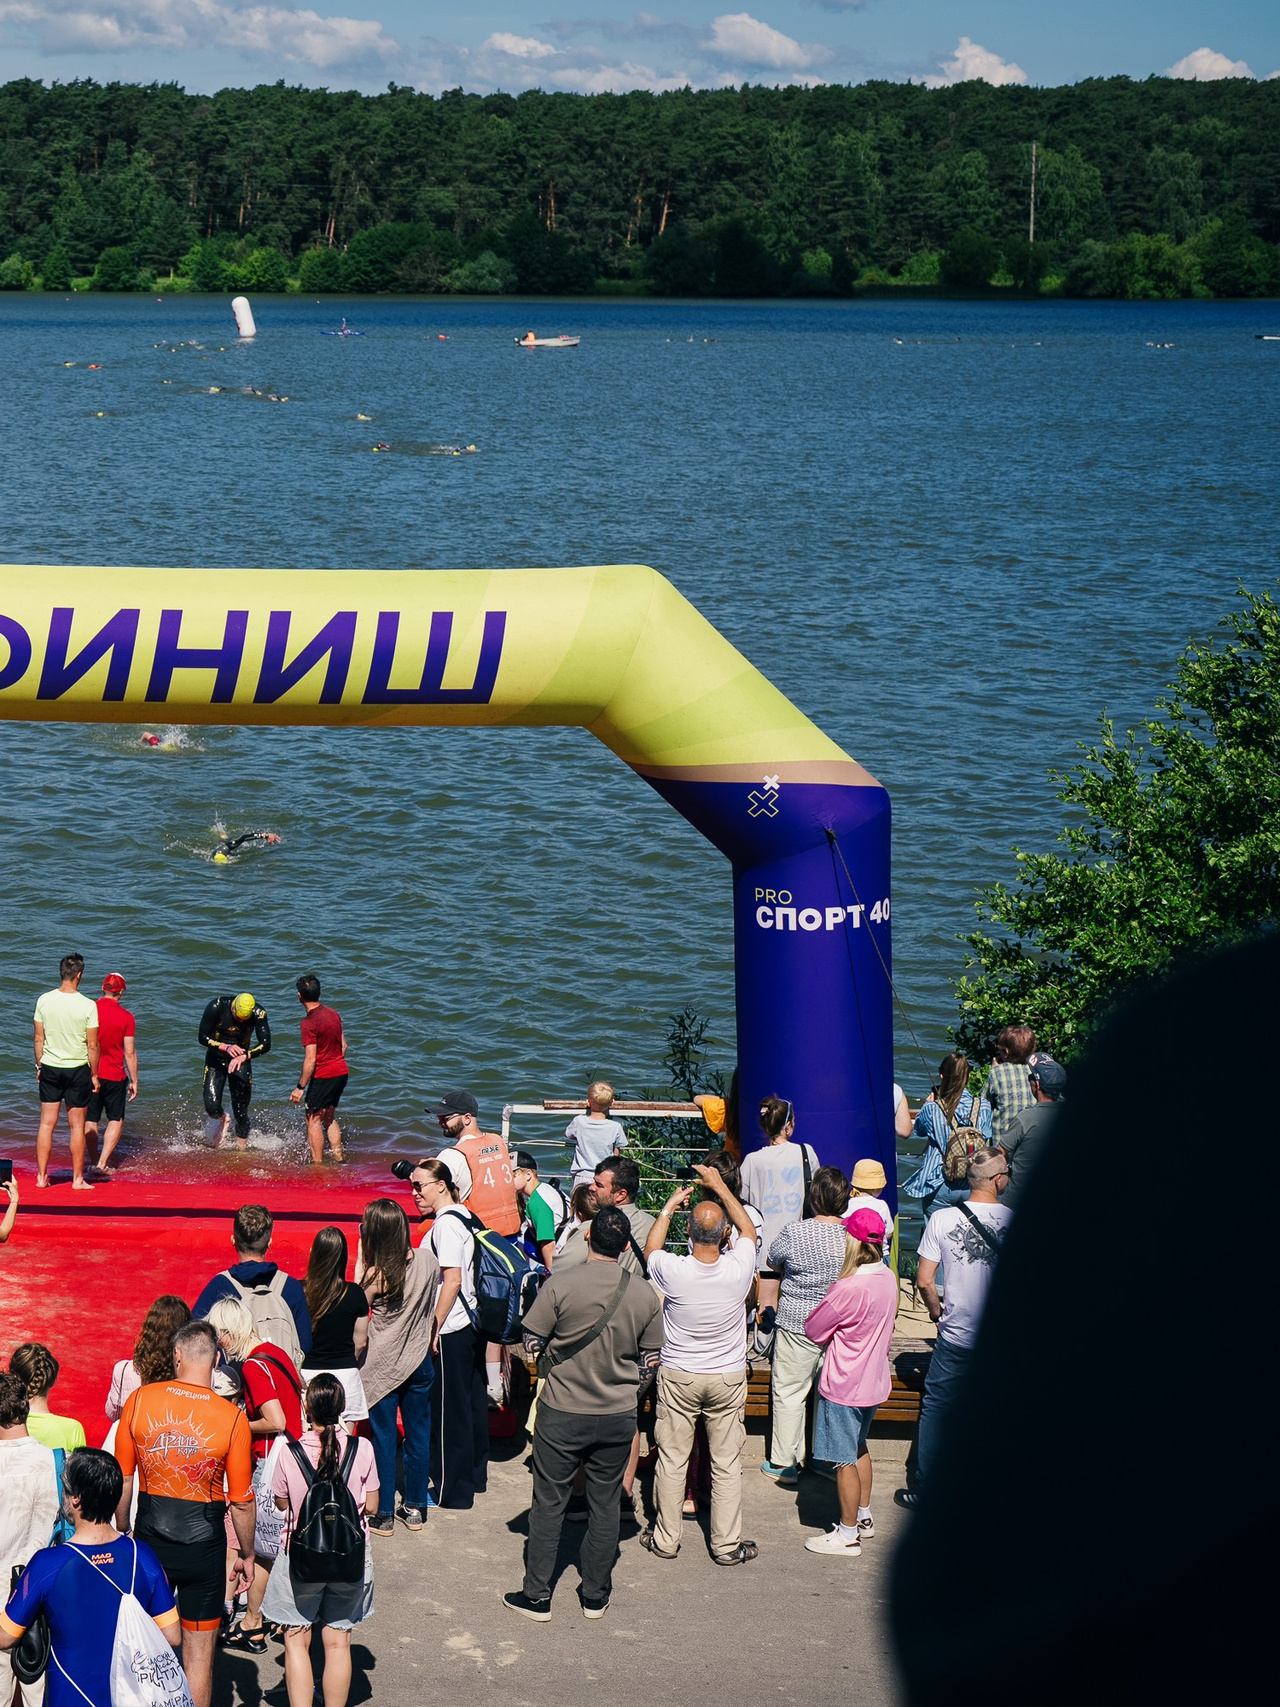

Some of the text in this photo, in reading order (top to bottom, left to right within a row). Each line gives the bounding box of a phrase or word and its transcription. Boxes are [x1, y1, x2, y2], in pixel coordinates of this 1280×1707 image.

[755, 887, 793, 905] PRO
[756, 897, 891, 932] СПОРТ 40
[763, 1191, 802, 1214] 29
[166, 1386, 211, 1401] МУДРЕЦКИЙ
[91, 1552, 112, 1560] MAD
